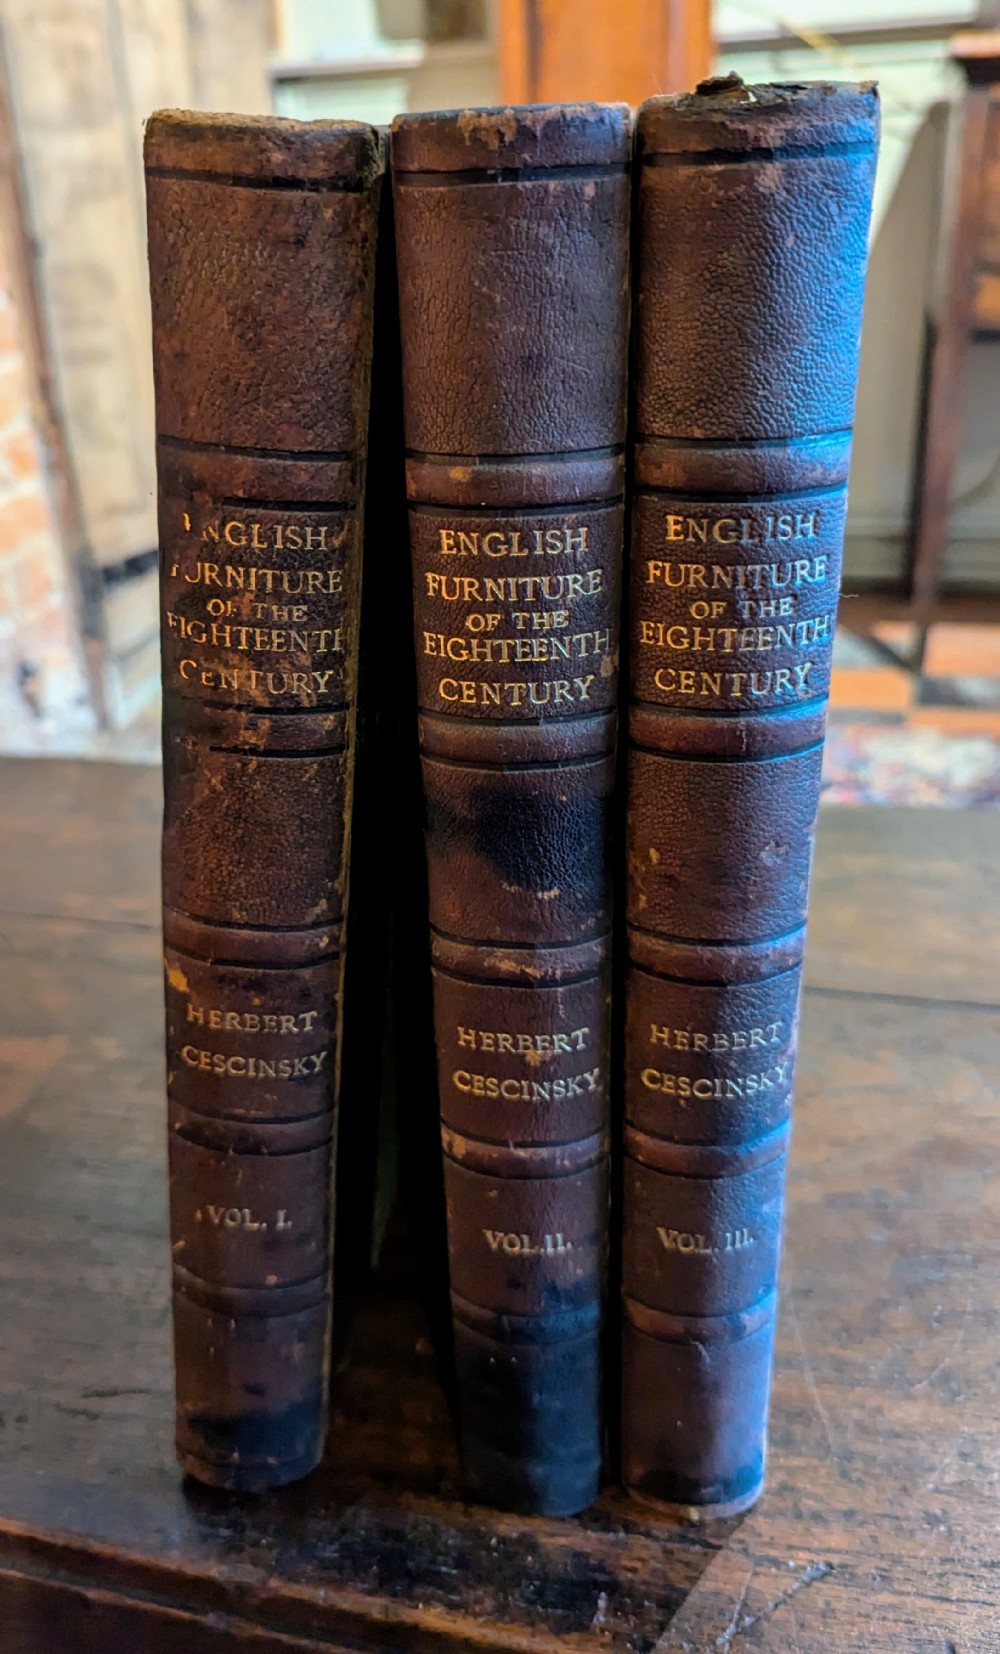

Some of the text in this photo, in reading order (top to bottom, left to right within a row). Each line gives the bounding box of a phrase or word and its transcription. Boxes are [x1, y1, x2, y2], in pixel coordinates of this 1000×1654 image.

[439, 527, 589, 557] ENGLISH
[665, 512, 817, 545] ENGLISH
[425, 569, 603, 601] FURNITURE
[645, 555, 828, 589] FURNITURE
[253, 602, 308, 622] THE
[466, 610, 570, 632] OF THE
[689, 597, 793, 619] OF THE
[423, 628, 612, 663] EIGHTEENTH
[640, 615, 830, 652] EIGHTEENTH
[438, 674, 595, 706] CENTURY
[654, 662, 812, 696] CENTURY
[186, 1003, 318, 1034] HERBERT
[457, 1026, 590, 1054] HERBERT
[650, 1022, 783, 1052] HERBERT
[180, 1045, 327, 1078] CESCINSKY
[452, 1067, 600, 1101] CESCINSKY
[641, 1061, 789, 1099] CESCINSKY
